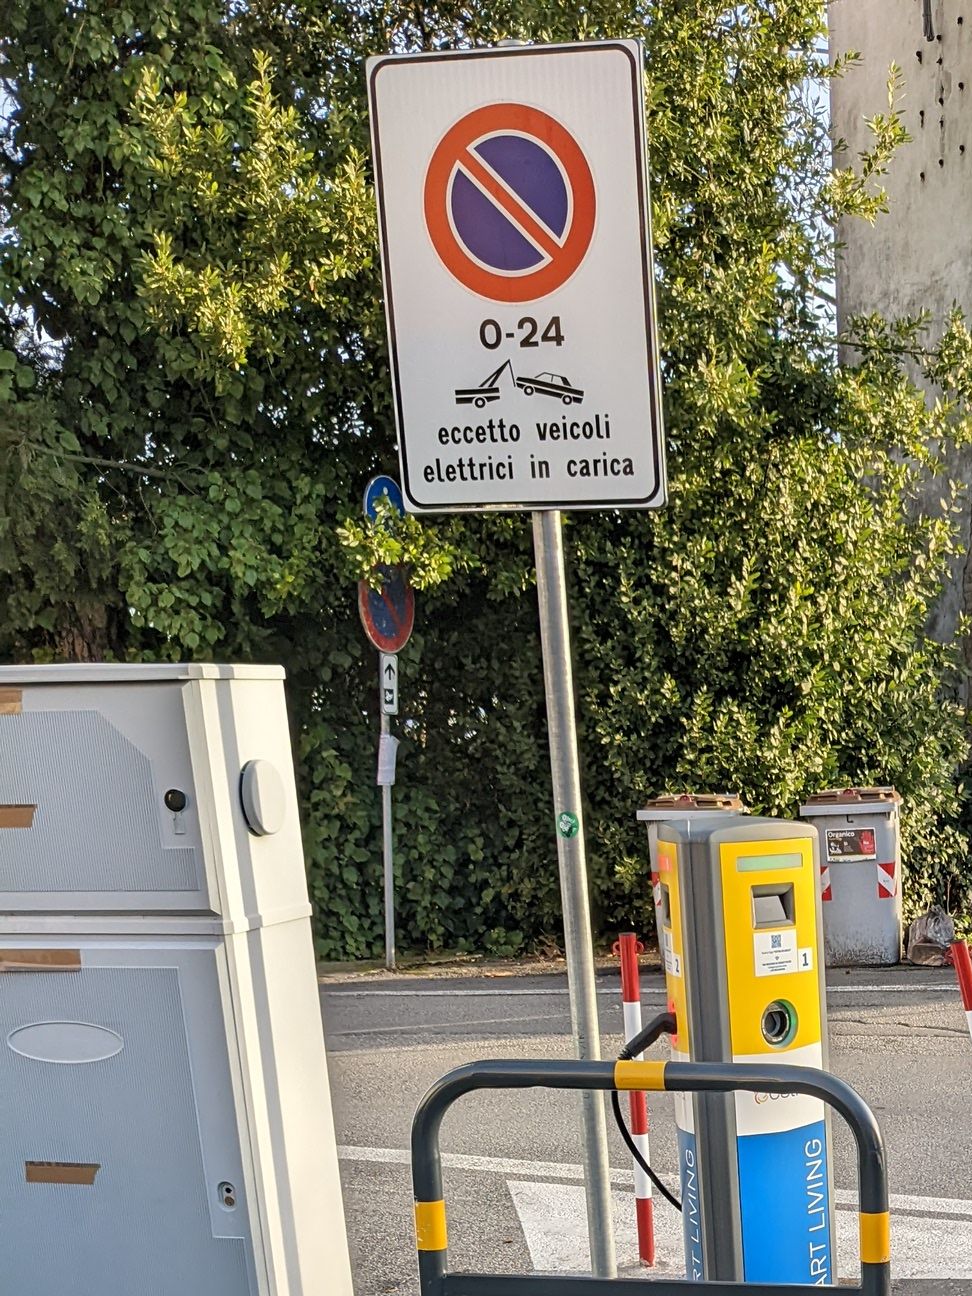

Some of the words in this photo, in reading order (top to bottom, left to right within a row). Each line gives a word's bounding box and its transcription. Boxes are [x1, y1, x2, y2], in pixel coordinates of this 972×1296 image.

[479, 316, 565, 350] 0-24
[437, 417, 521, 445] eccetto
[535, 413, 611, 441] veicoli
[423, 454, 514, 483] elettrici
[529, 453, 551, 479] in
[566, 451, 635, 477] carica
[827, 830, 856, 839] Organico
[802, 952, 809, 967] 1
[685, 1149, 701, 1244] LIVING
[805, 1138, 827, 1233] LIVING
